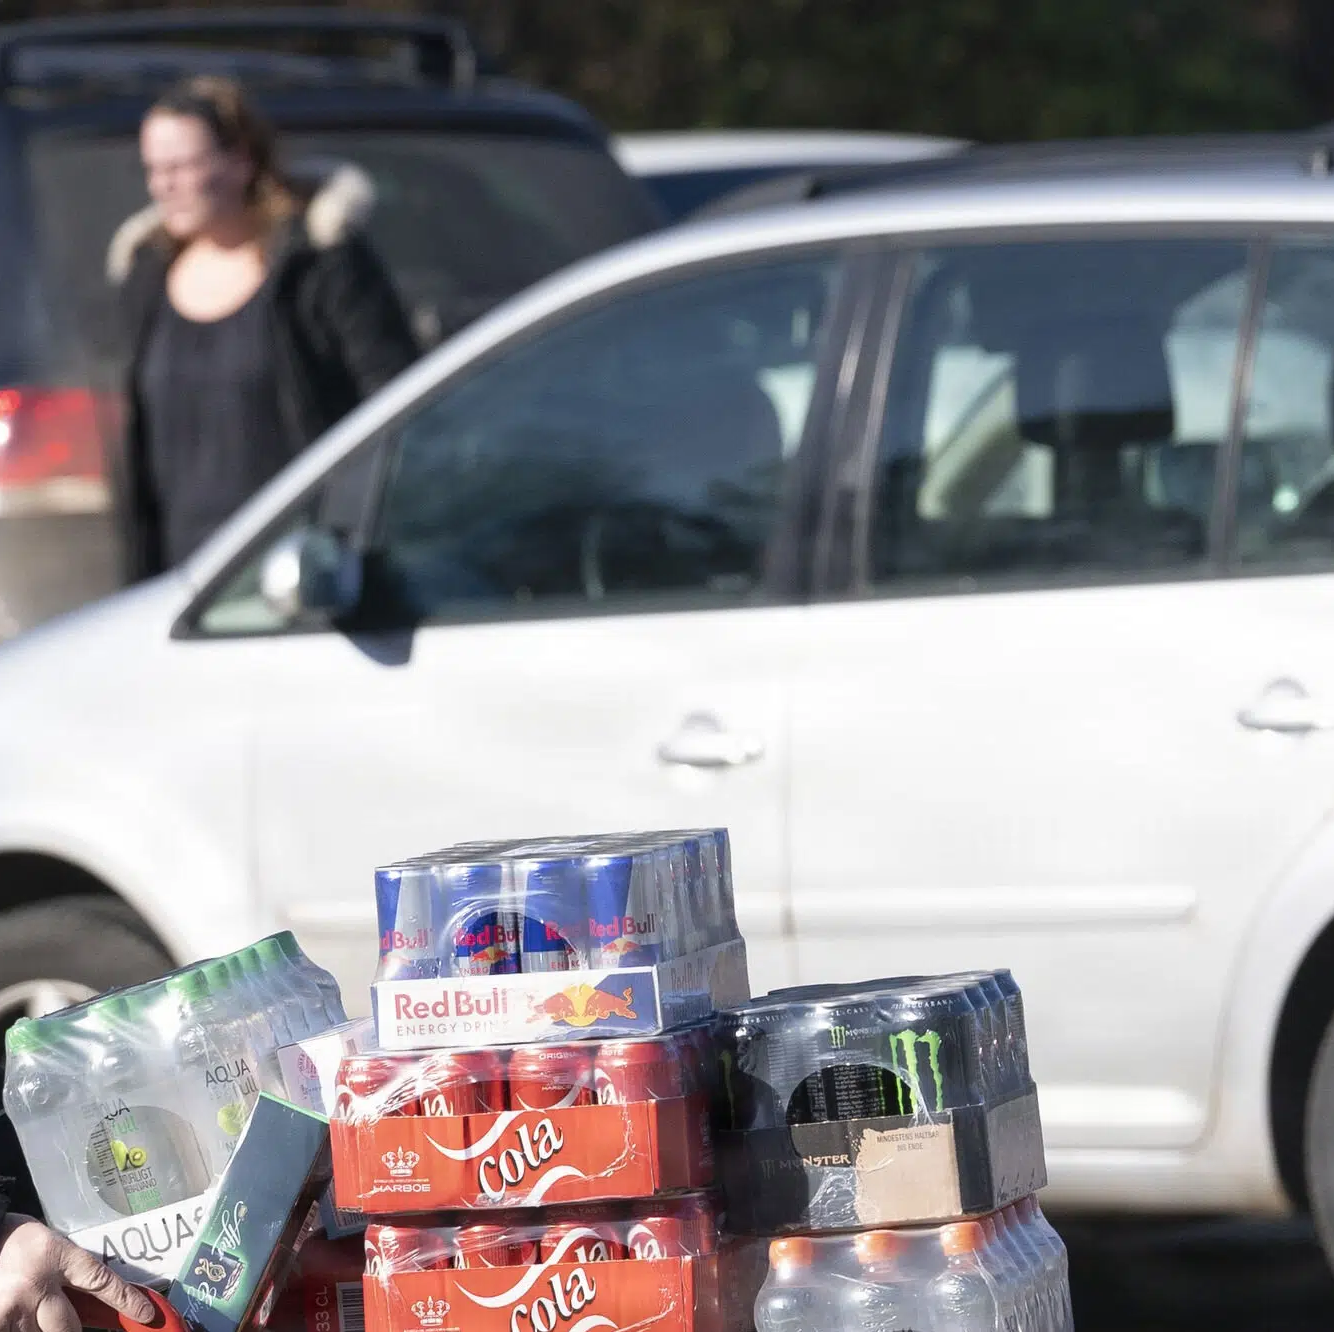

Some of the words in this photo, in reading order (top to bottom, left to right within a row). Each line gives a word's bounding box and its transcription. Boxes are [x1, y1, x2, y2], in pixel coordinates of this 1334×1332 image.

[621, 912, 657, 936] Bull
[393, 989, 451, 1021] Red
[455, 985, 509, 1017] Bull
[396, 1020, 459, 1037] ENERGY
[204, 1058, 251, 1088] AQUA
[779, 1152, 852, 1172] MONSTER
[372, 1183, 431, 1193] HARBOE
[211, 1200, 247, 1262] After
[315, 1285, 330, 1310] CL
